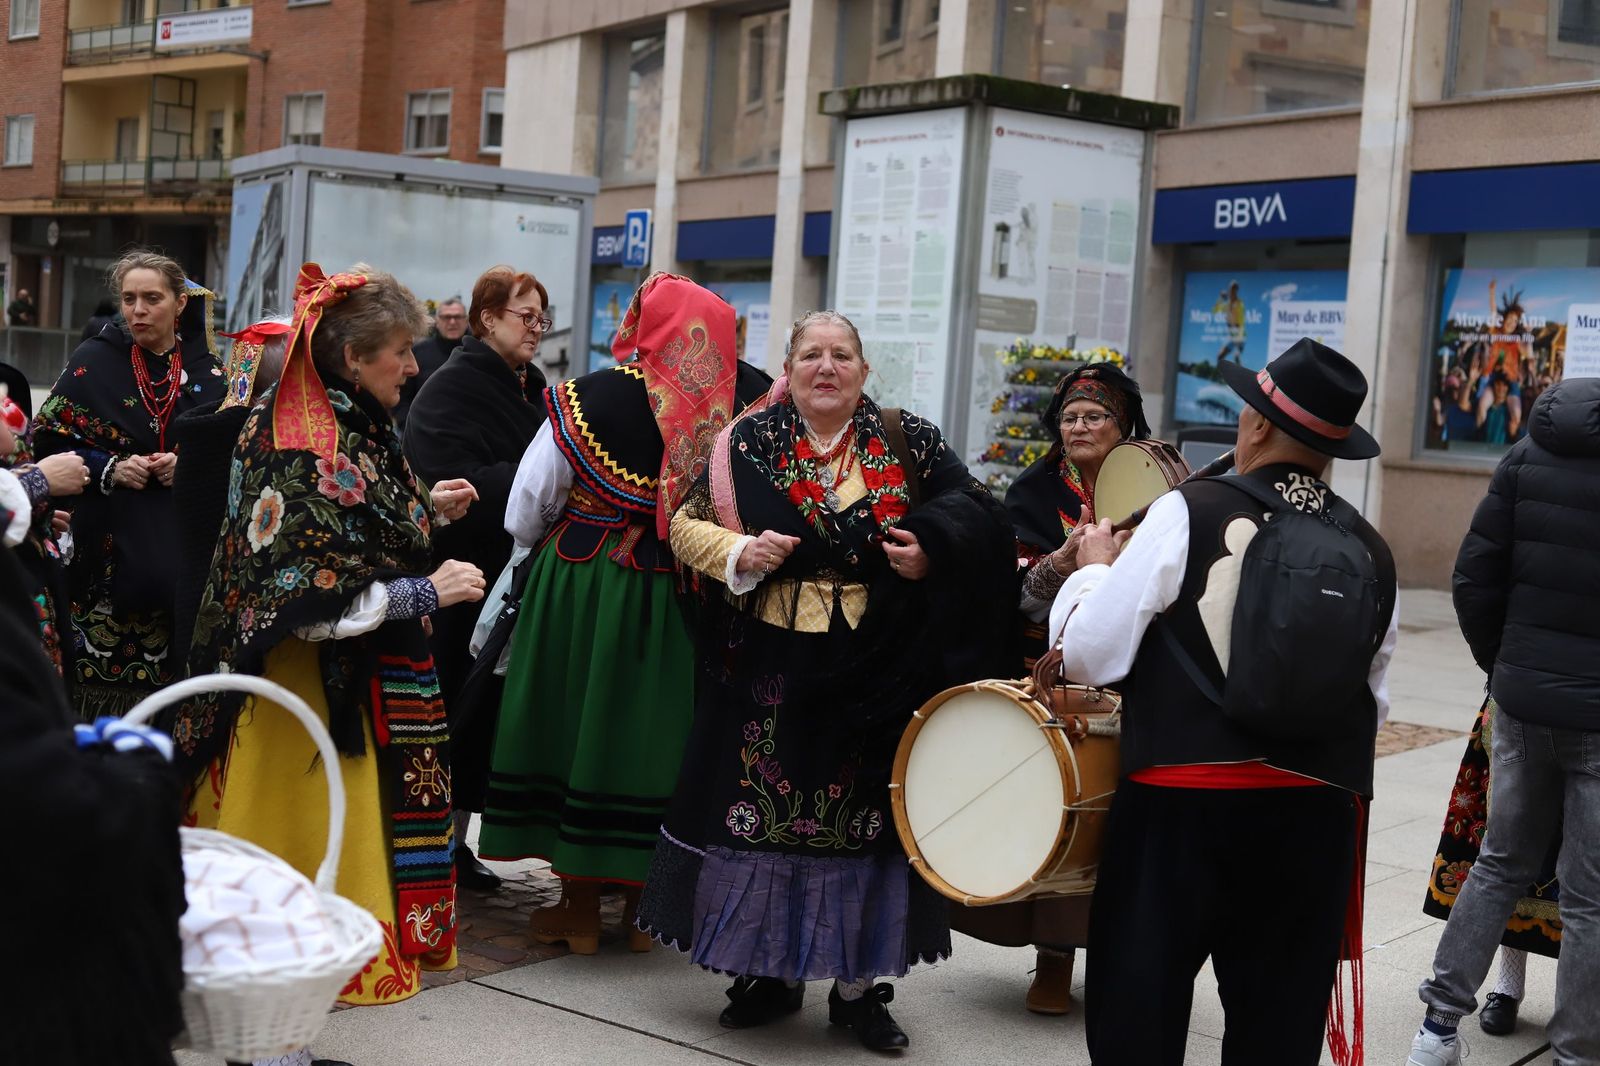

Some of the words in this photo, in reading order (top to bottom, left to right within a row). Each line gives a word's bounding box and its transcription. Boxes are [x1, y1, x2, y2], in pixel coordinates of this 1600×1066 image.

[1214, 192, 1287, 229] BBVA
[627, 217, 643, 261] P
[1277, 309, 1299, 326] Muy
[1303, 309, 1318, 324] de
[1319, 310, 1345, 325] BBV
[1454, 312, 1484, 332] Muy
[1487, 312, 1504, 328] de
[1519, 312, 1546, 328] Ana
